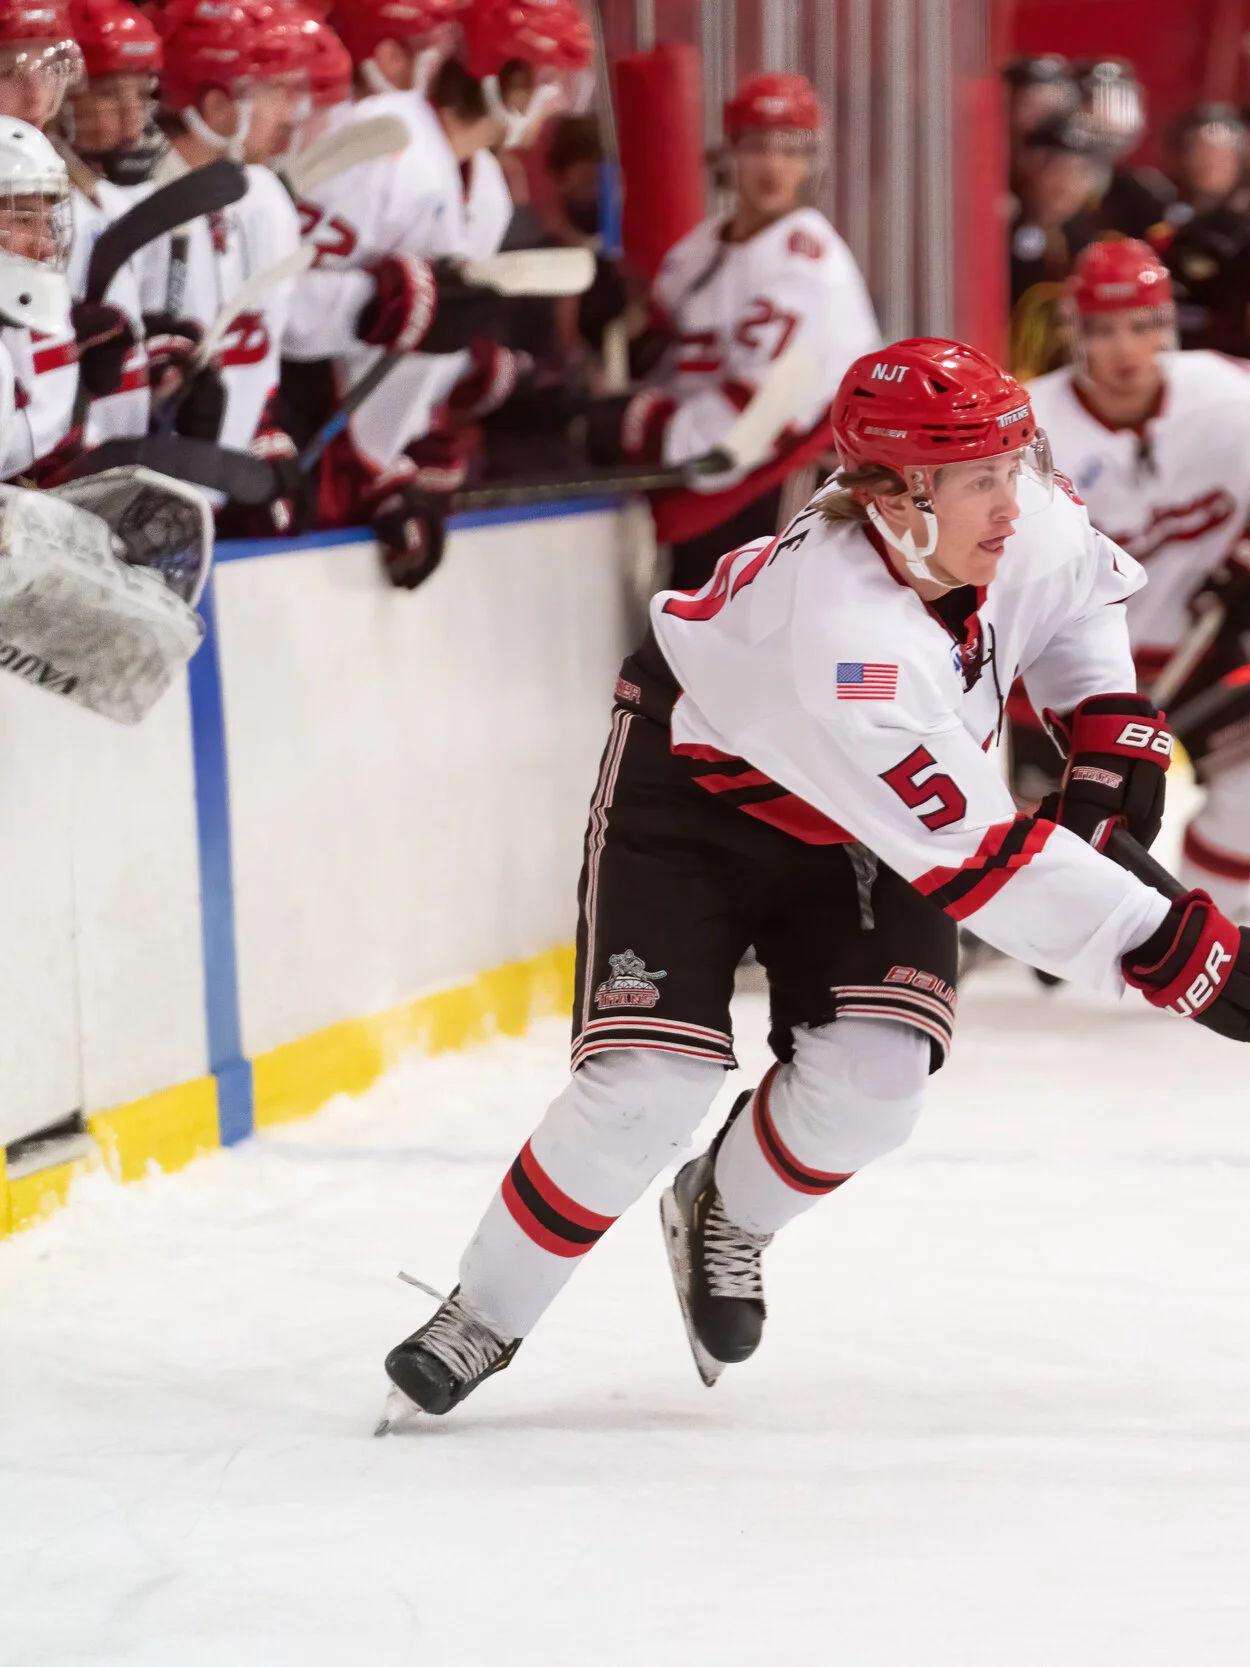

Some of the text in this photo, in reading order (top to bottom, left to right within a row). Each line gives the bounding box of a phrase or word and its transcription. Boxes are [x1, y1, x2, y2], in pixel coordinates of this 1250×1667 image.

[736, 294, 802, 362] 27
[871, 363, 910, 383] NJT
[877, 743, 967, 832] 5
[595, 989, 659, 1010] TITANS
